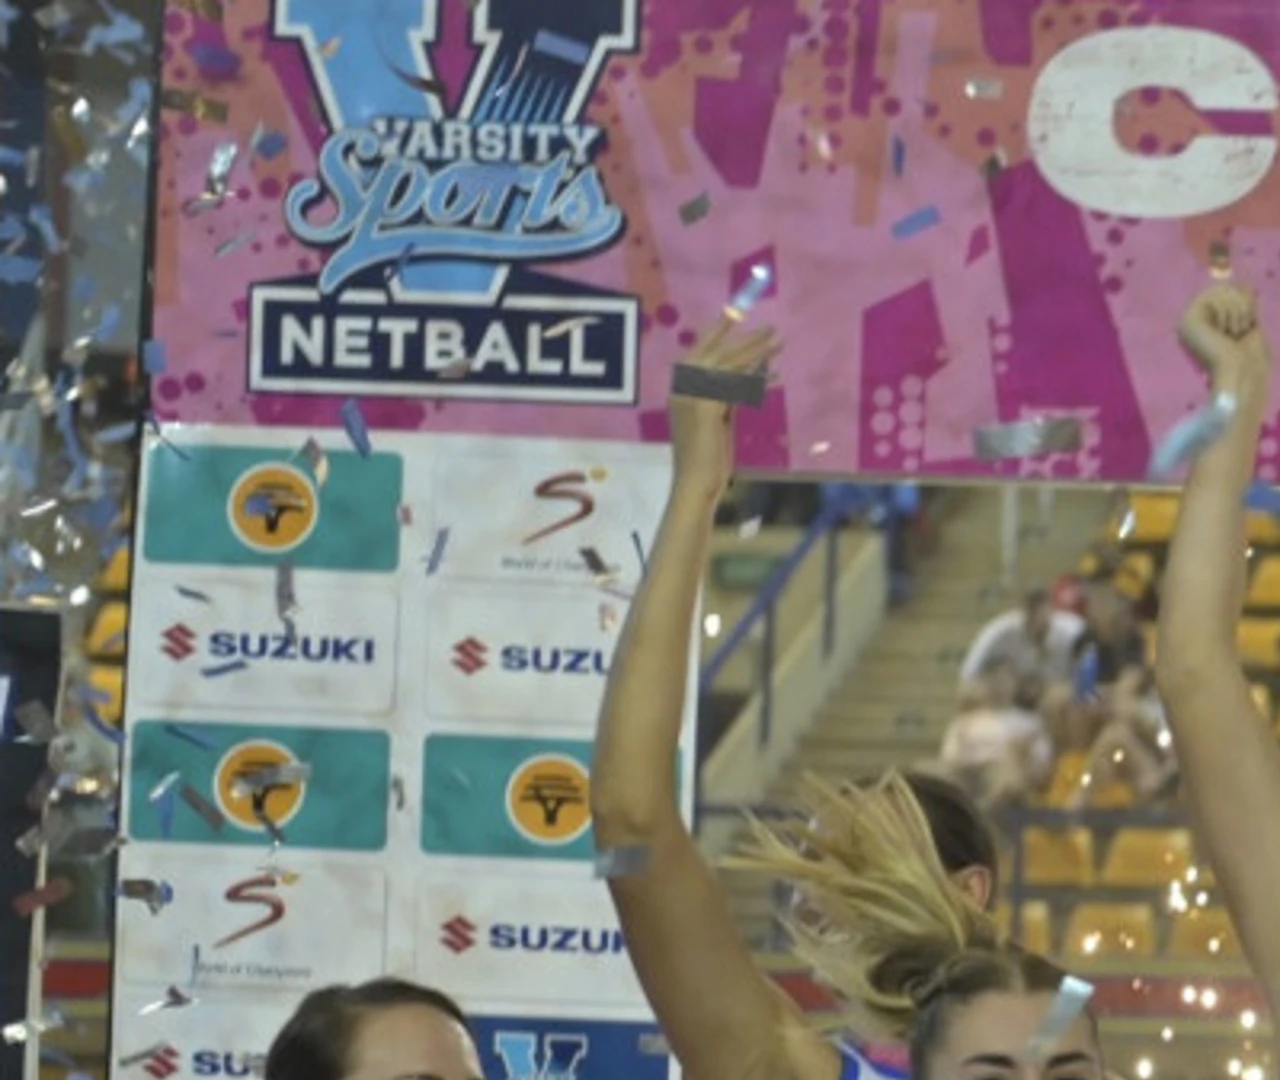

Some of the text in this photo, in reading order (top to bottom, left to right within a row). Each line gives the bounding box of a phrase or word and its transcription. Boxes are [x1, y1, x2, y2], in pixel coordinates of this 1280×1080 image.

[372, 118, 602, 165] VARSITY
[284, 127, 627, 295] Sports
[280, 314, 606, 376] NETBALL
[208, 632, 376, 666] SUZUKI
